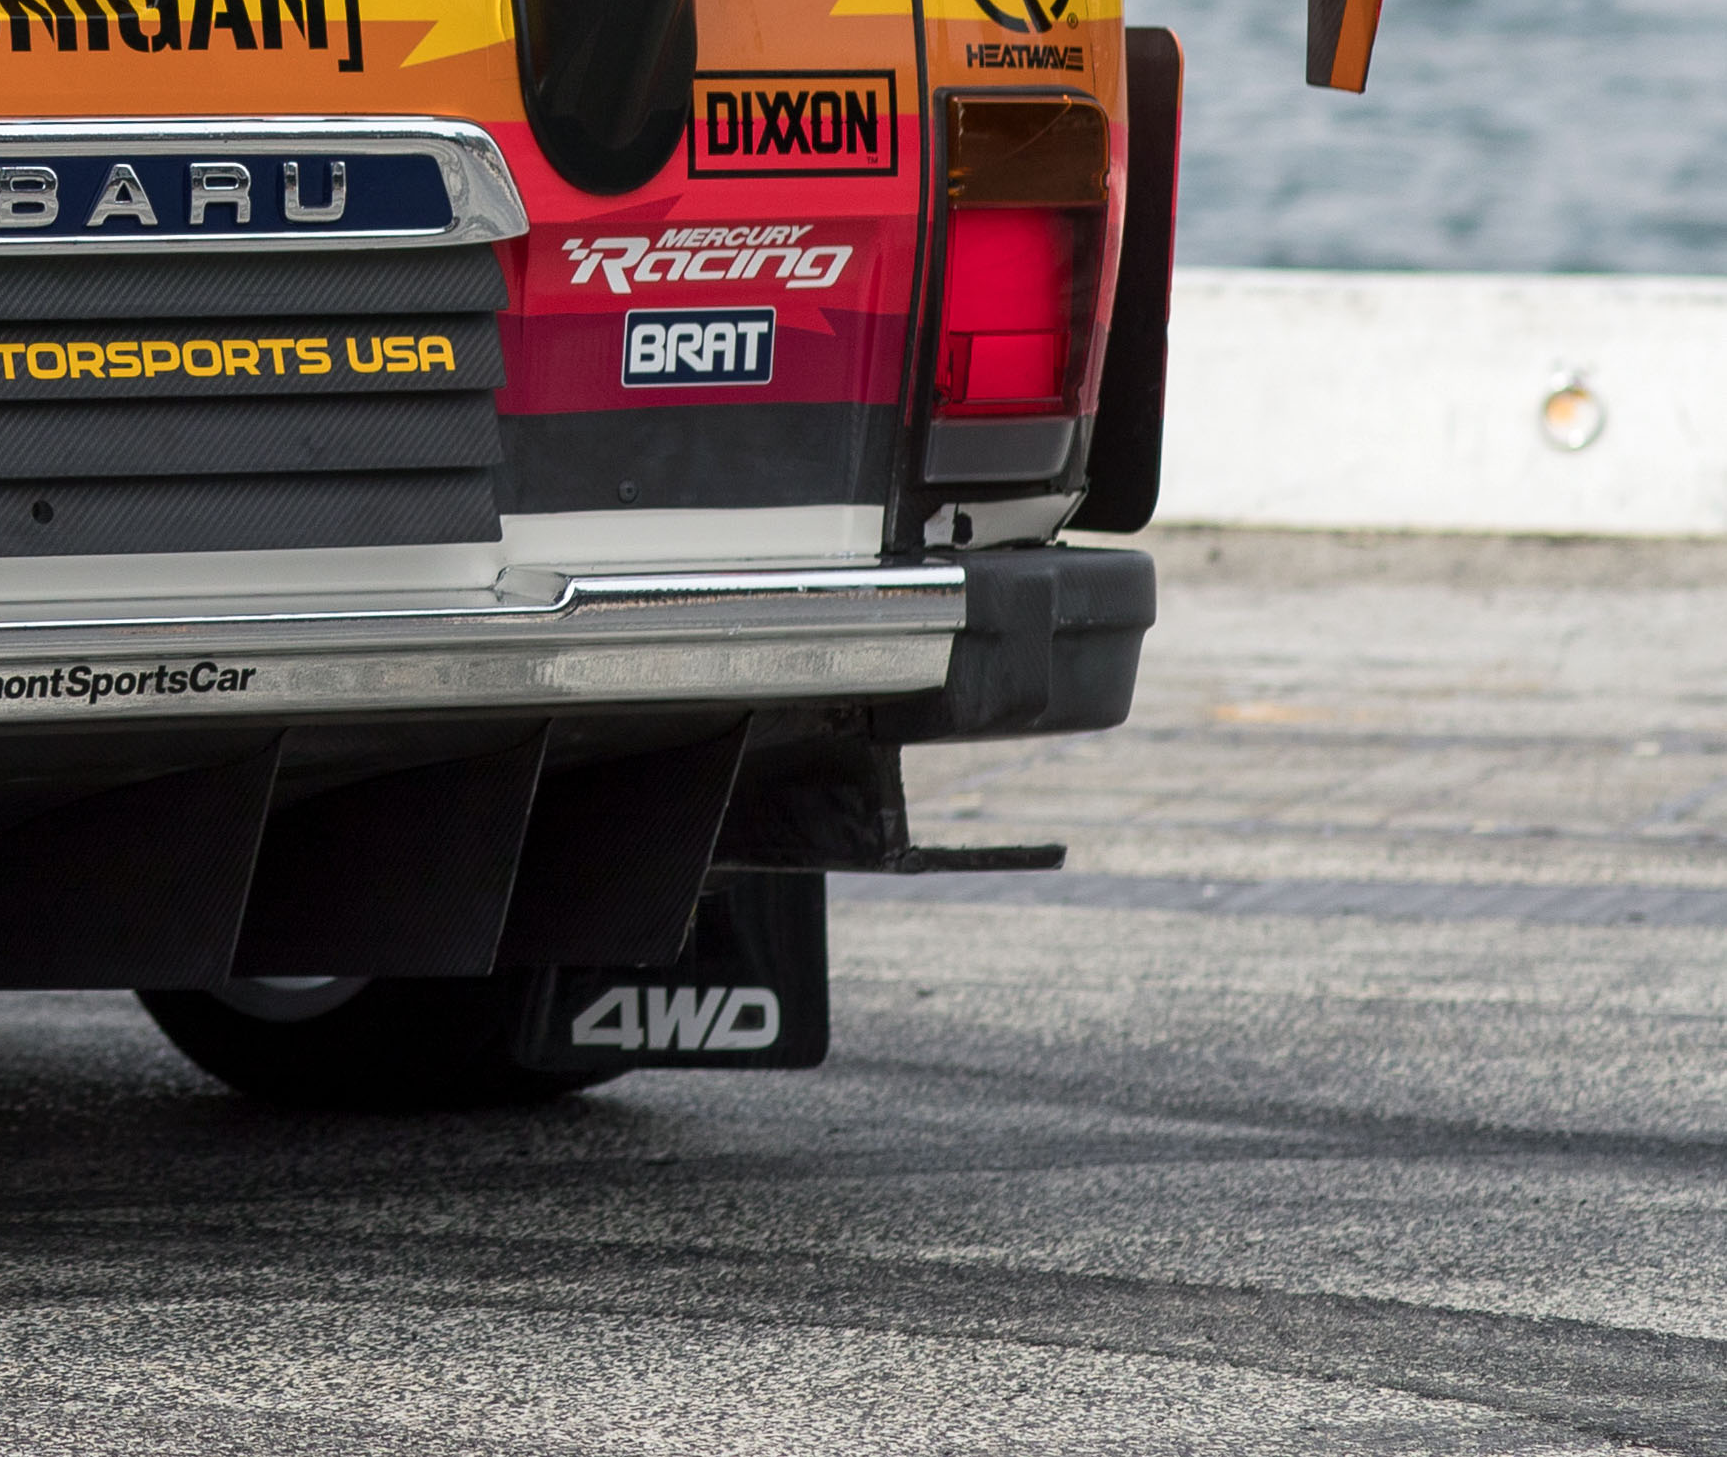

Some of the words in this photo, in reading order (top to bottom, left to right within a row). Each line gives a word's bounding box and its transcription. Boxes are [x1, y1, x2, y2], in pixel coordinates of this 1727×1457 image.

[967, 44, 1084, 70] HEATWAVE
[707, 91, 877, 156] DIXXON
[655, 225, 814, 248] MERCURY
[562, 236, 853, 294] Racing
[346, 335, 457, 373] USA
[628, 322, 769, 373] BRAT
[573, 986, 780, 1050] 4WD
